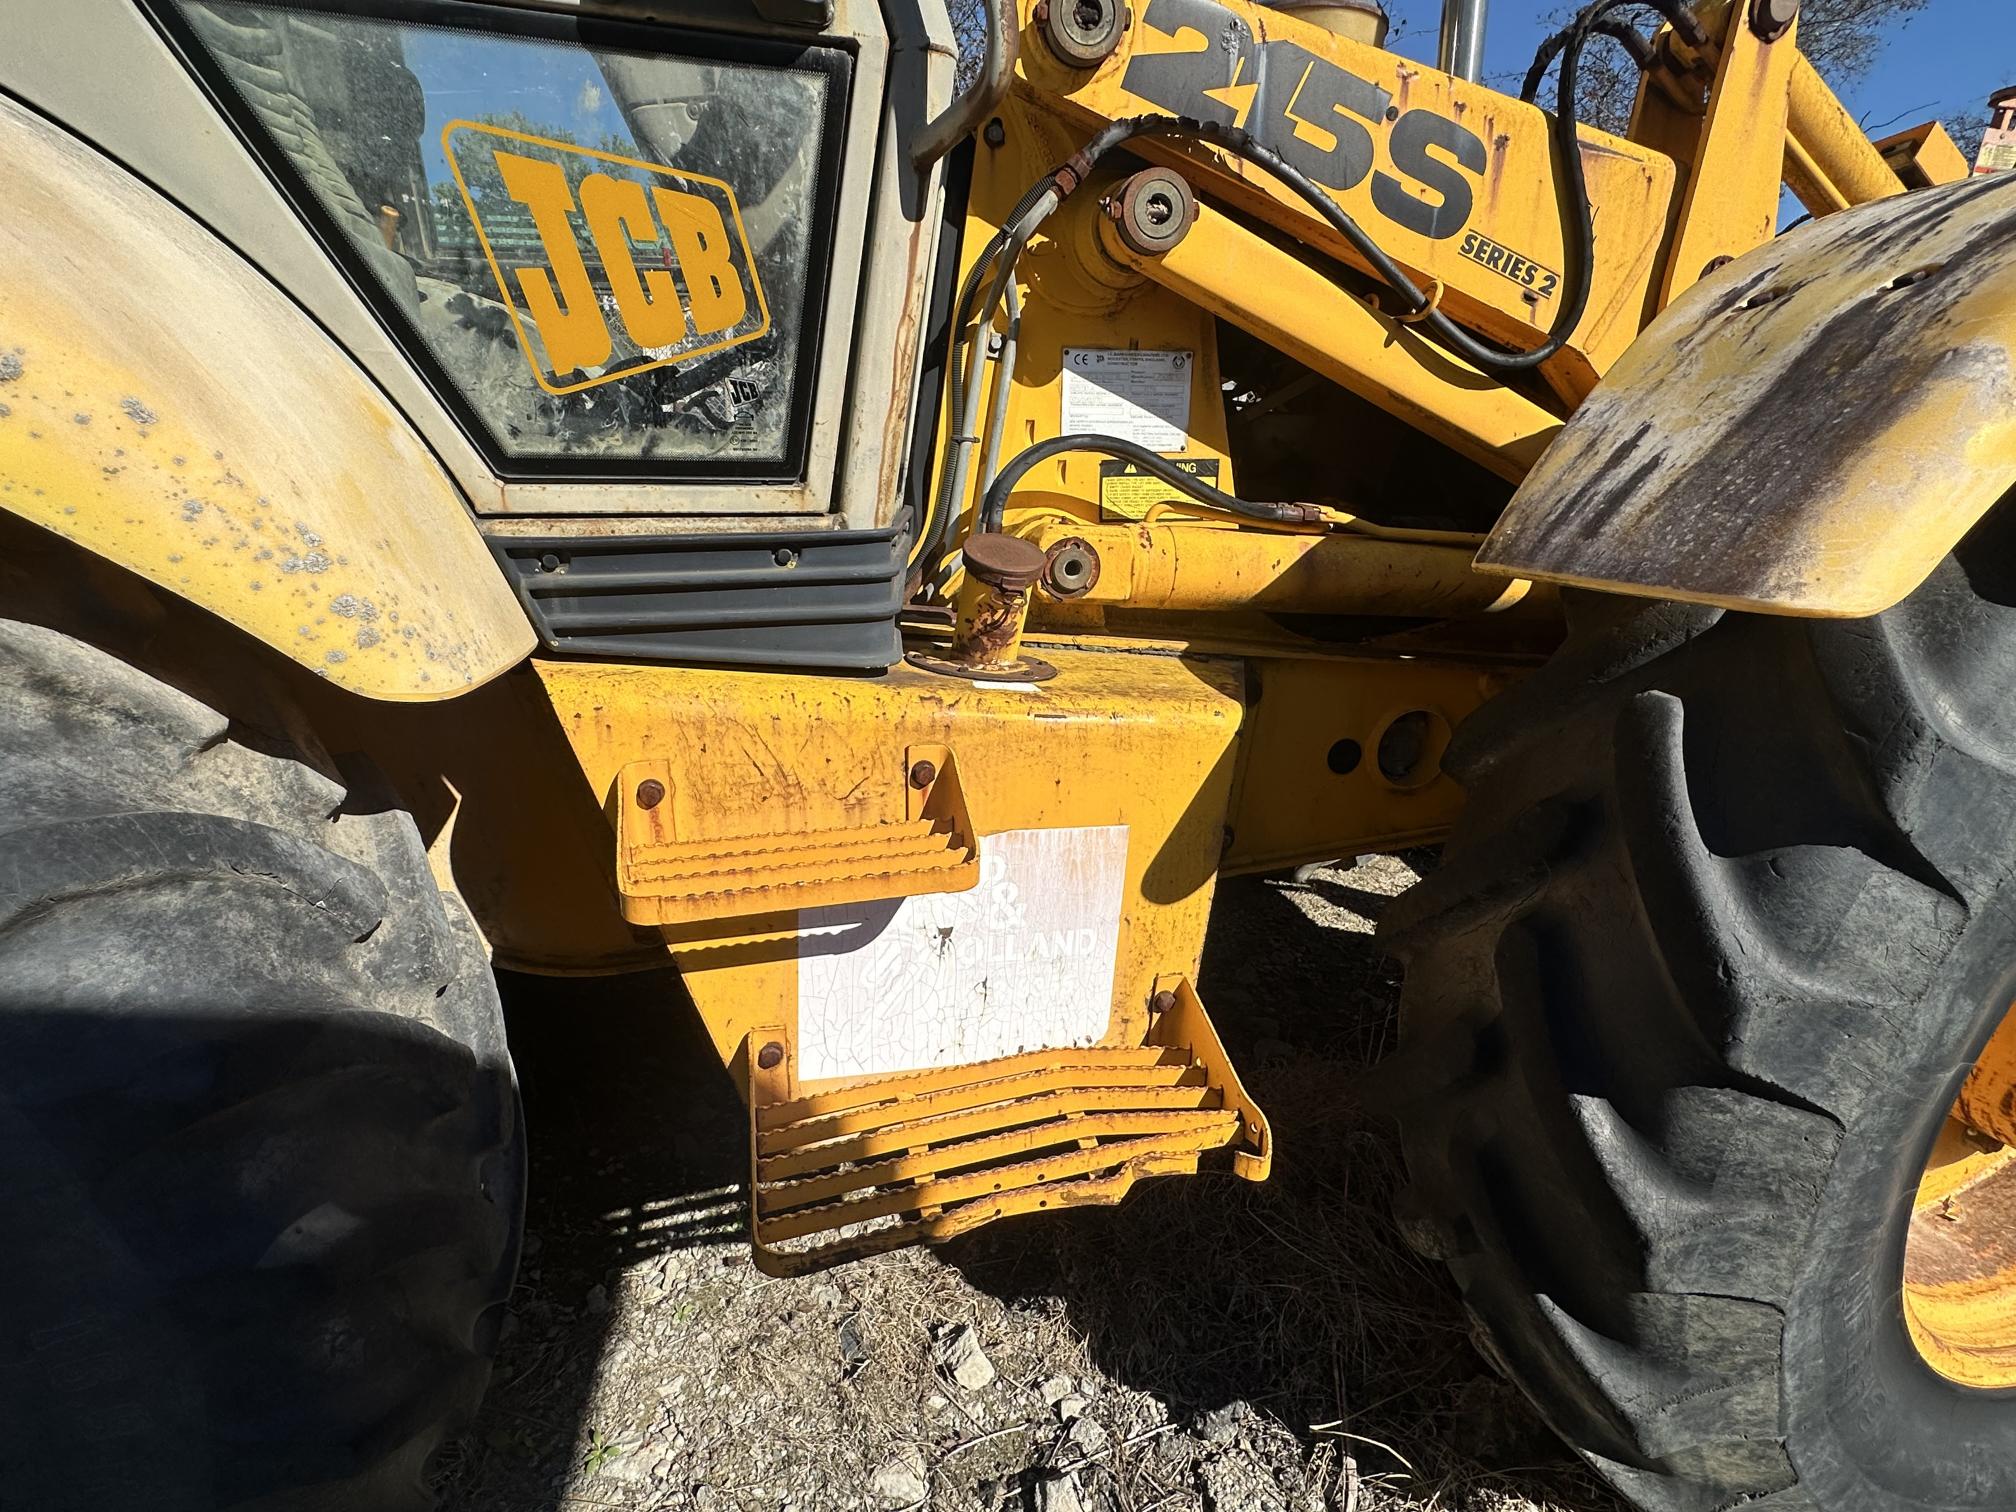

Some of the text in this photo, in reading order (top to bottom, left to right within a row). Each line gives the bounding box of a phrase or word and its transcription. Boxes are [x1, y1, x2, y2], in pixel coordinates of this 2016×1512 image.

[493, 150, 746, 377] JCB
[1460, 233, 1557, 297] SERIES 2
[729, 379, 759, 405] JCB
